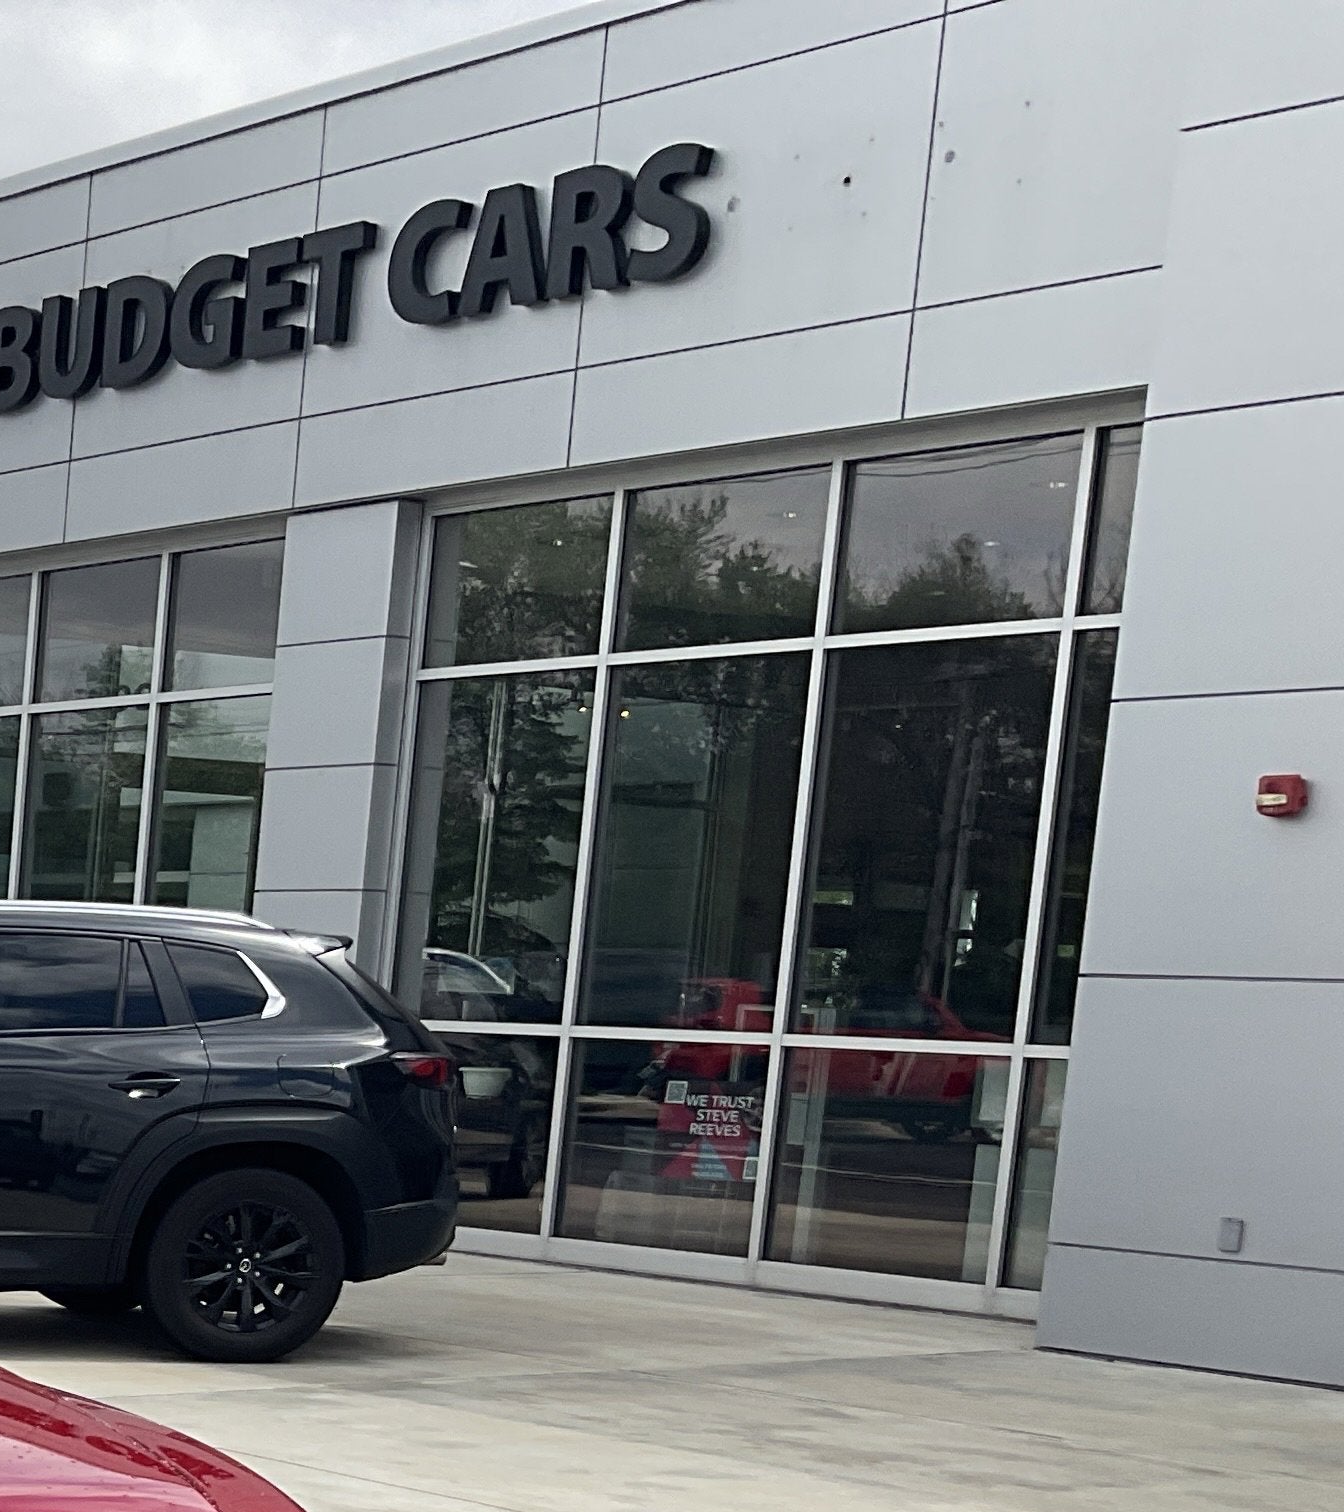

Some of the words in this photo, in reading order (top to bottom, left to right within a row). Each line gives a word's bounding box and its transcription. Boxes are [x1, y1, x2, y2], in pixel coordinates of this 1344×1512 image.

[388, 143, 714, 326] CARS
[686, 1094, 708, 1107] WE
[712, 1095, 755, 1109] TRUST
[696, 1110, 739, 1122] STEVE
[689, 1123, 741, 1137] REEVES
